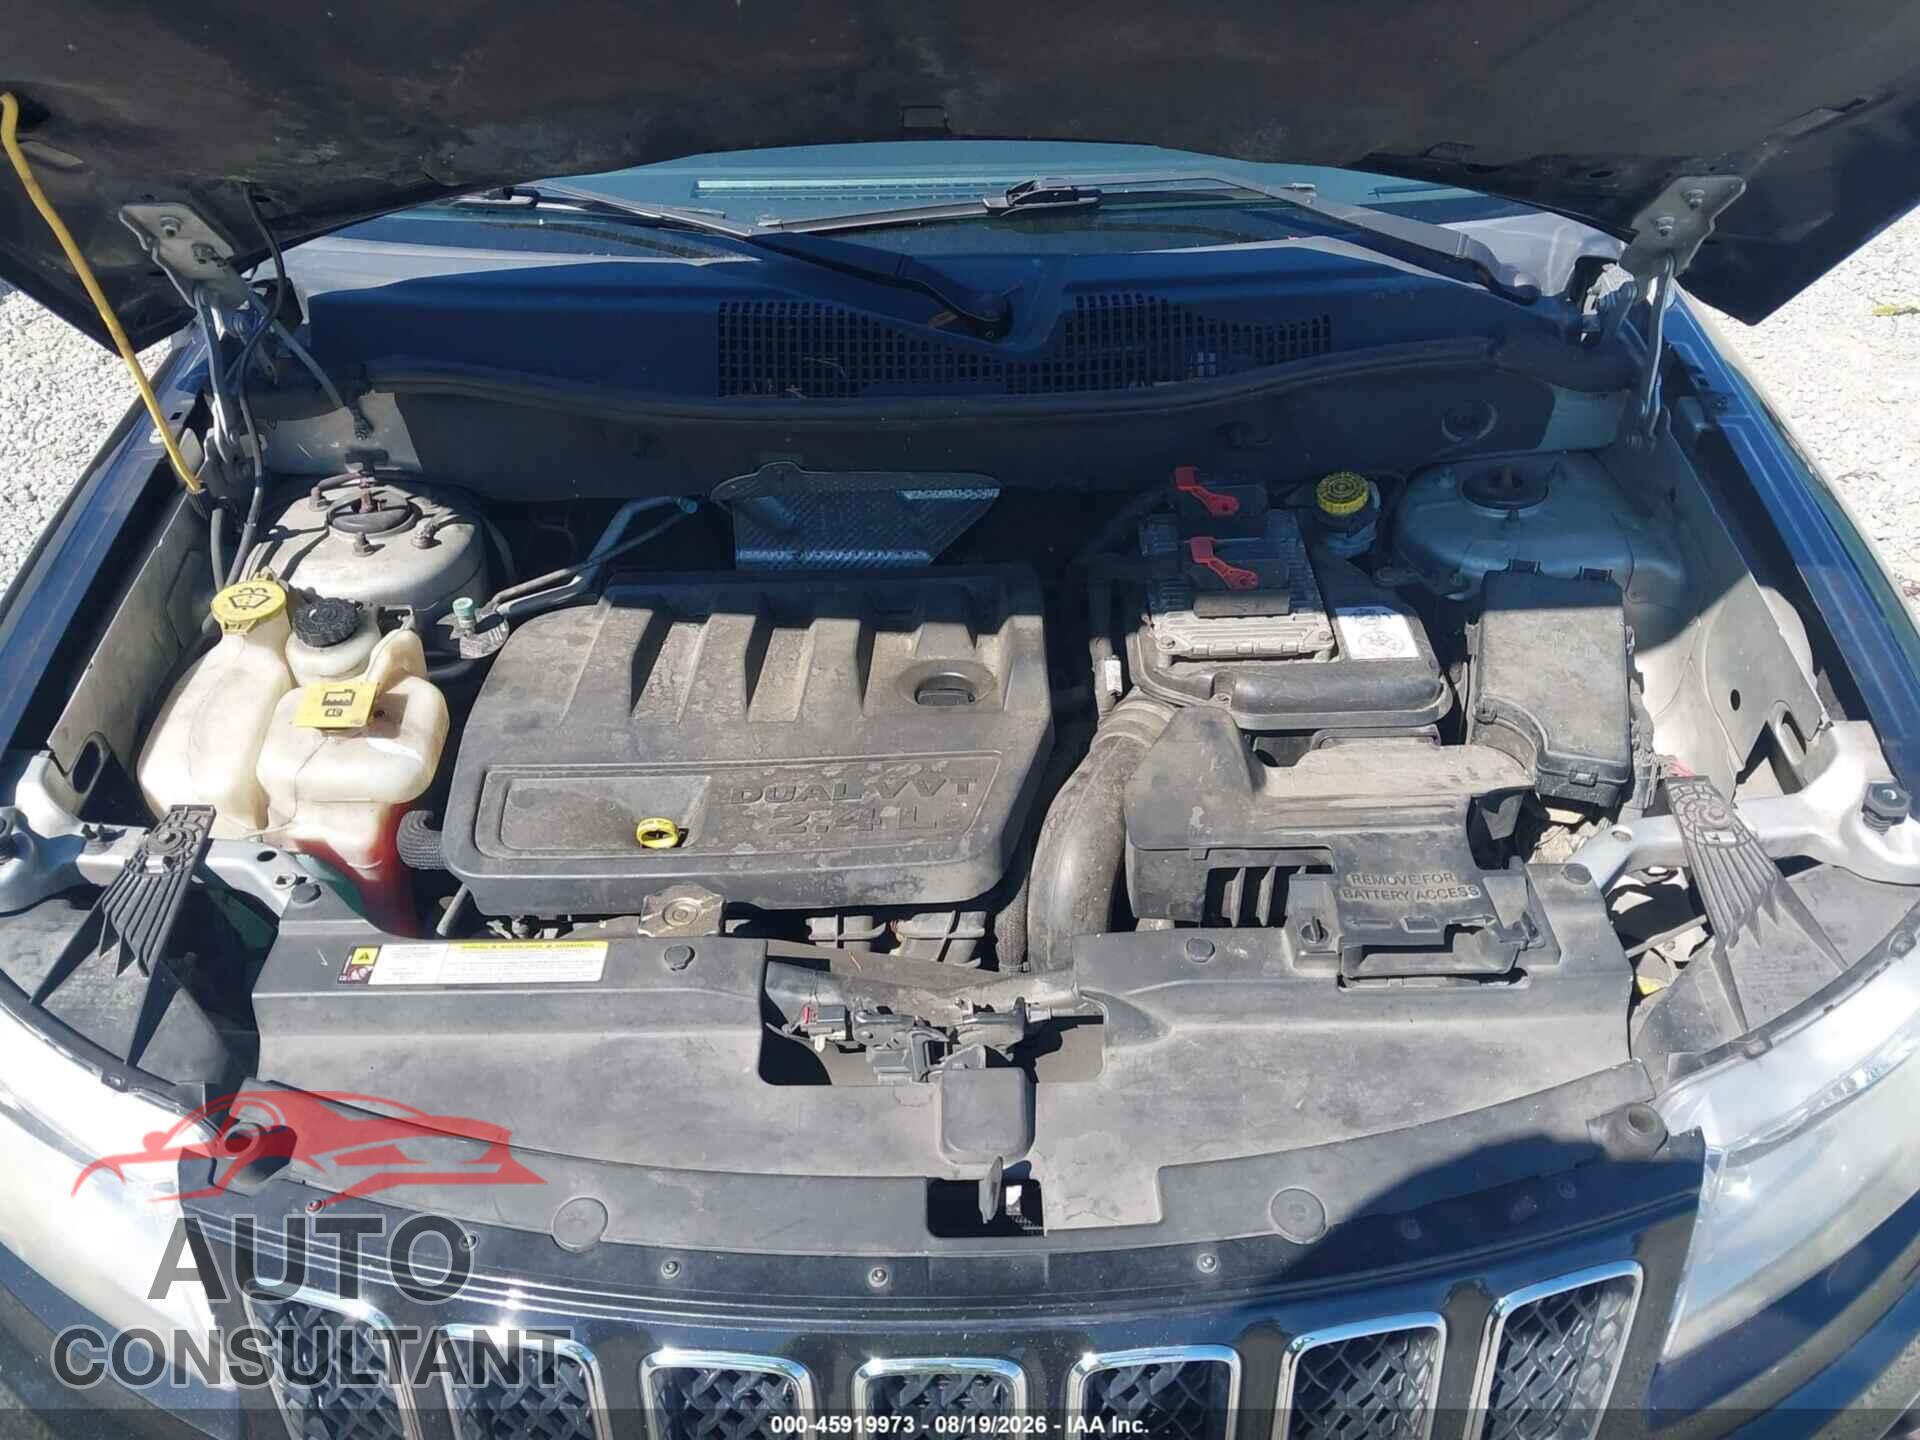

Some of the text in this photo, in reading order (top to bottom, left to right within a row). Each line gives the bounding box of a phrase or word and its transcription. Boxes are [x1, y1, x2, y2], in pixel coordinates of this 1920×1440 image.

[730, 775, 978, 805] DUAL VVT
[1350, 872, 1455, 886] REMOVE FOR
[1342, 886, 1480, 901] BATTERY ACCESS
